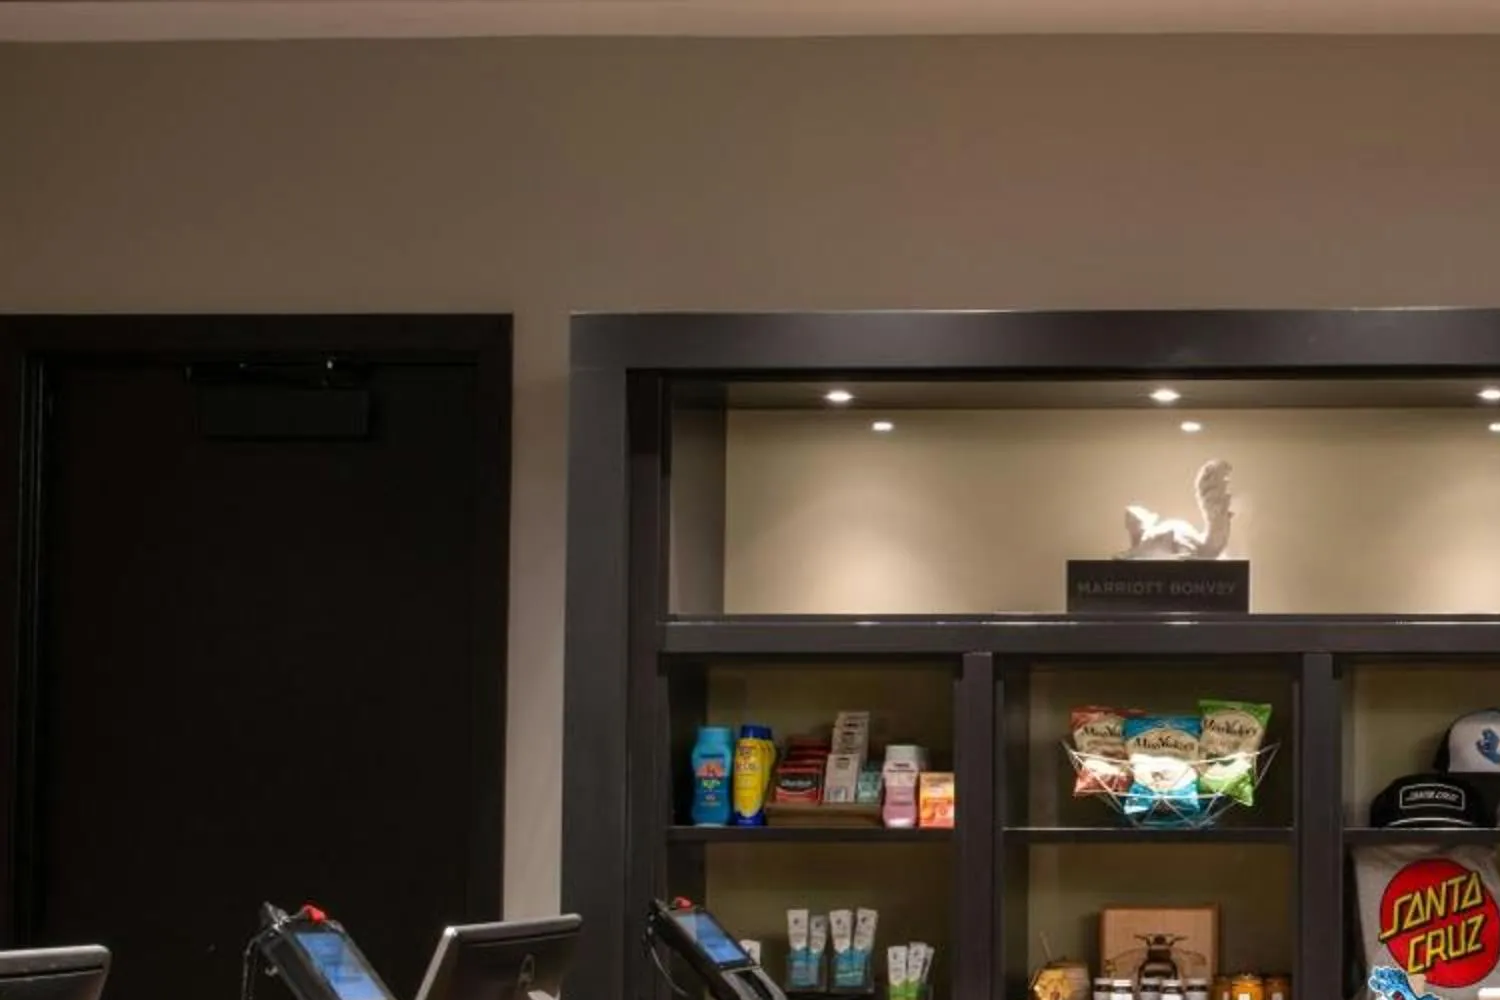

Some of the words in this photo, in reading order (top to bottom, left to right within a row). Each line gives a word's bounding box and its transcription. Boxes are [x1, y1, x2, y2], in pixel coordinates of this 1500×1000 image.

[1077, 580, 1164, 595] MARRIOTT
[1378, 871, 1485, 944] SANTA
[1405, 914, 1485, 975] CRUZ
